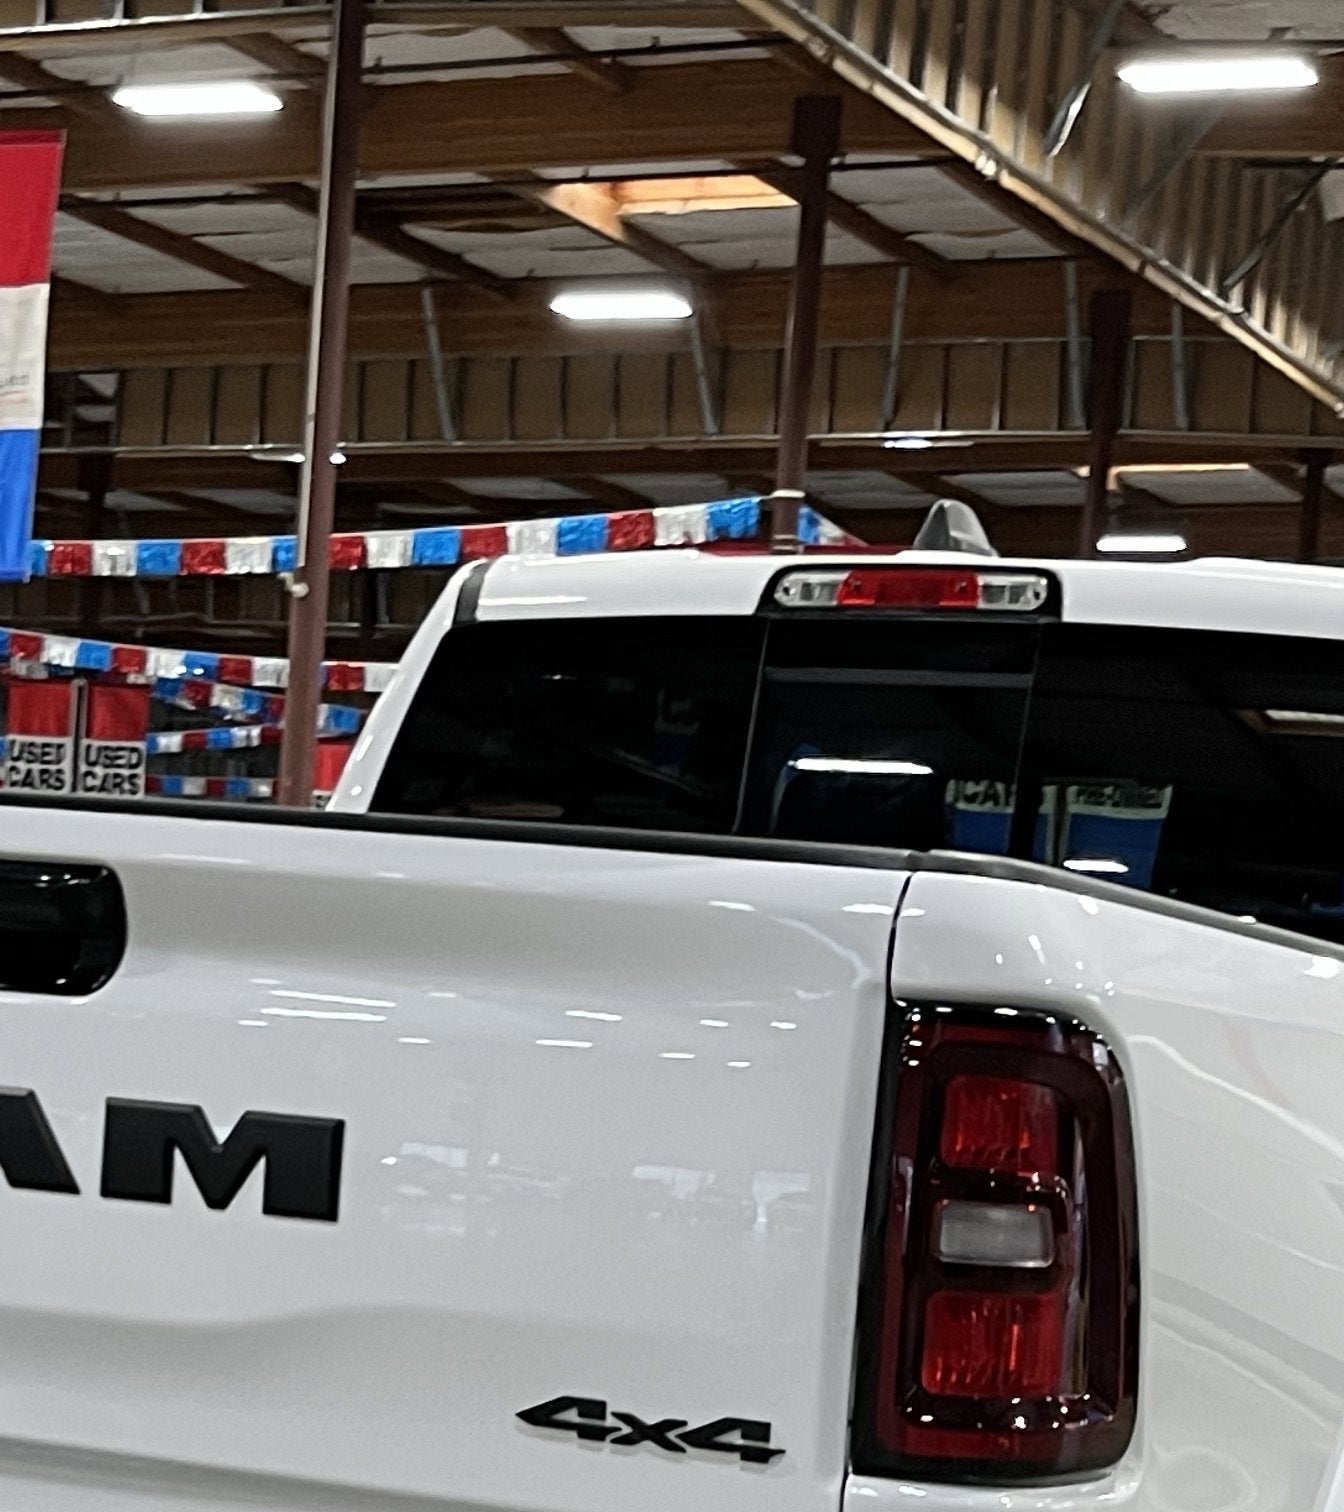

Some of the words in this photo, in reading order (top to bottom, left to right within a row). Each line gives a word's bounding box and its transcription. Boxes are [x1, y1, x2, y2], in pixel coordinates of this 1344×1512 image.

[9, 740, 65, 765] USED
[85, 744, 143, 769] USED
[8, 765, 65, 790] CARS
[83, 770, 140, 795] CARS
